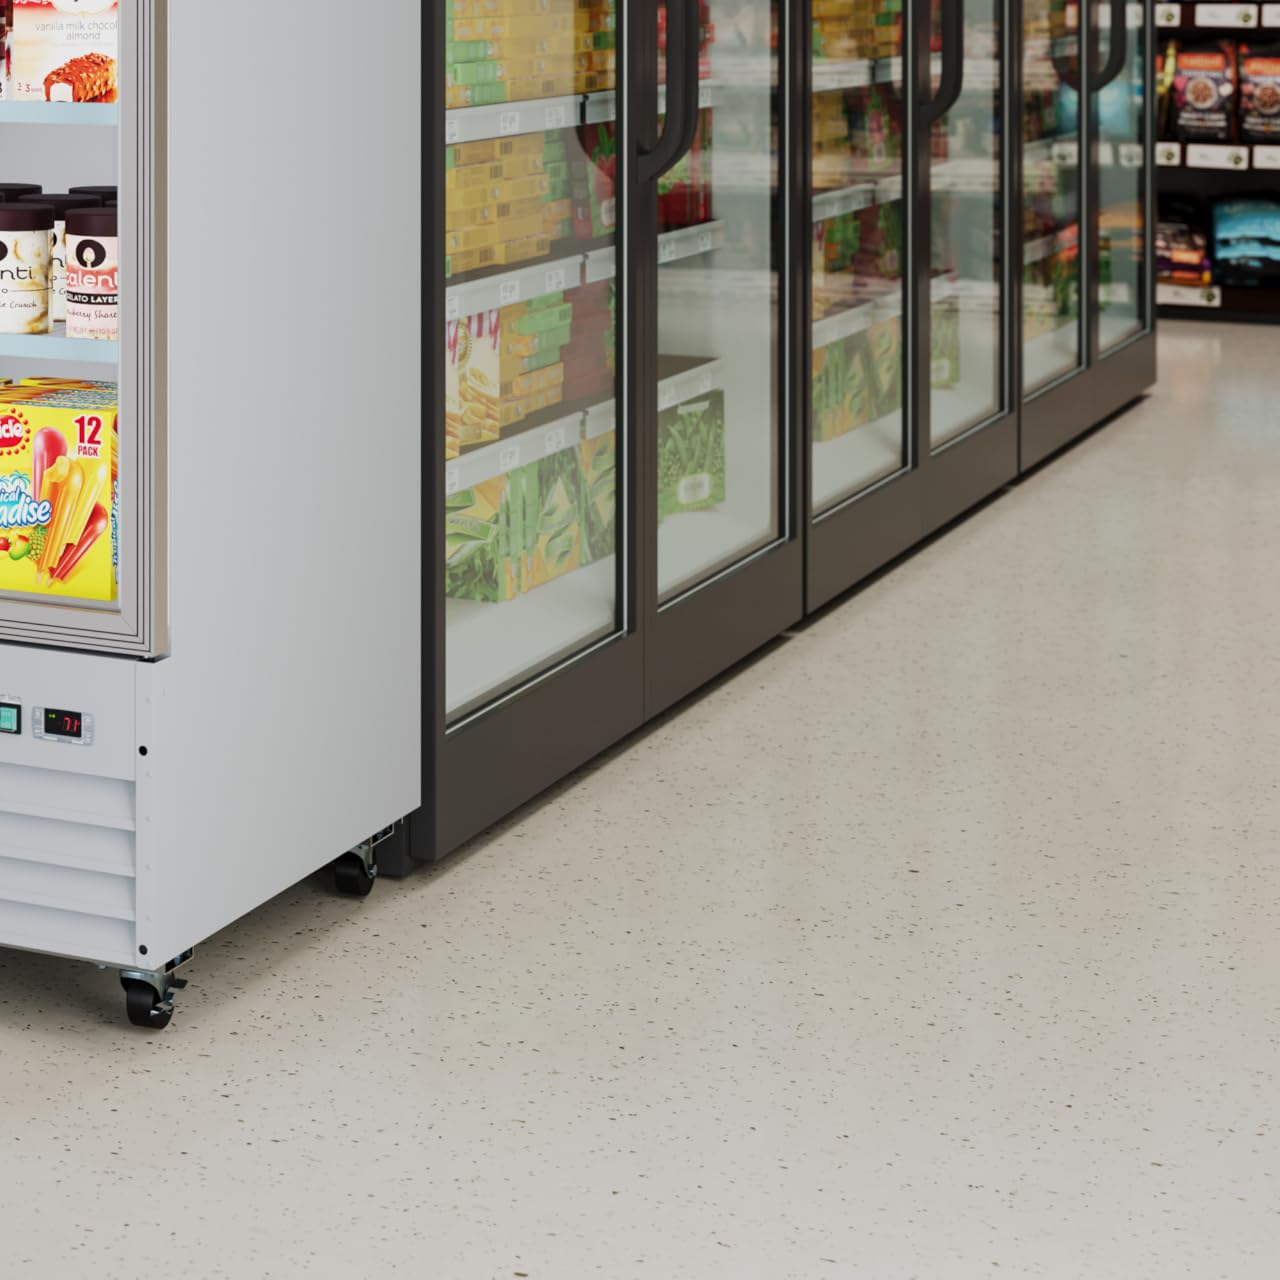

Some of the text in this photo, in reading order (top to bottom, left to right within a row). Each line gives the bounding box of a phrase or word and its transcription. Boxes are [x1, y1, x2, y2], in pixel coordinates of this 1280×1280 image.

[35, 22, 64, 31] vanilla
[88, 21, 118, 30] chocol
[66, 270, 118, 288] alen
[91, 295, 118, 304] LAYER
[94, 310, 118, 319] Short
[74, 415, 102, 445] 12
[77, 445, 99, 457] PACK
